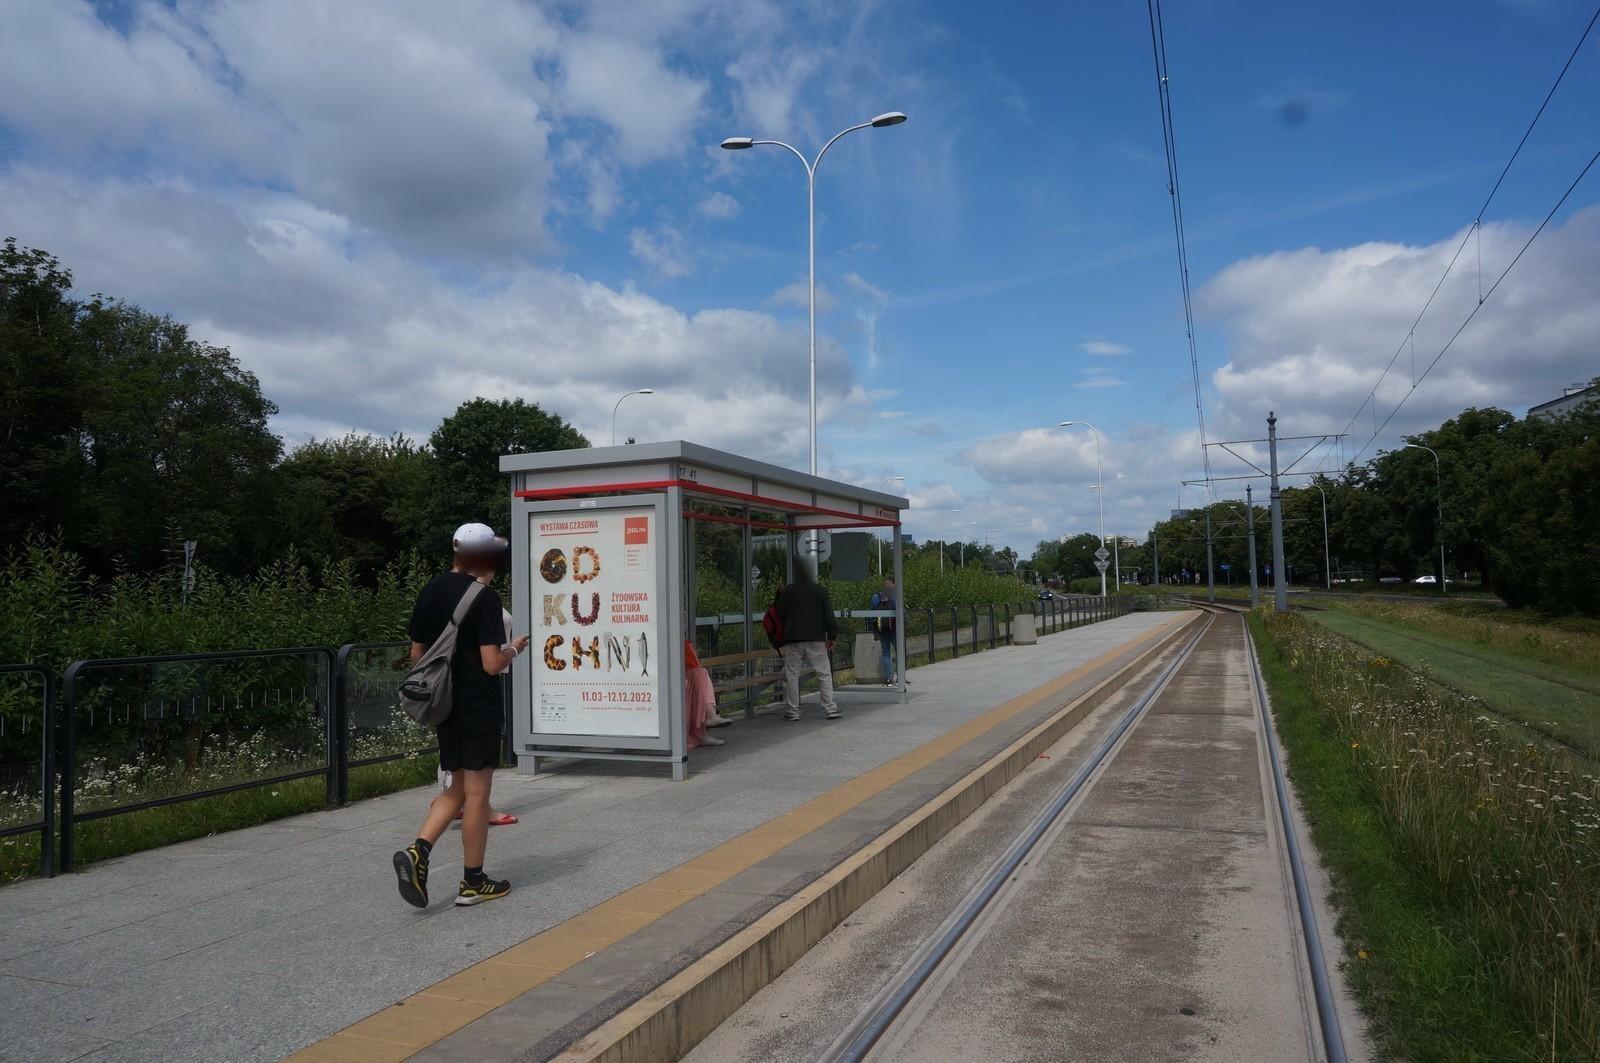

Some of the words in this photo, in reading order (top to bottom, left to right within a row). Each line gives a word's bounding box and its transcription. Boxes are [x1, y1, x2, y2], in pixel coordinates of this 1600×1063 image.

[540, 522, 568, 531] WYSTAWA
[570, 520, 599, 530] CZASOWA
[540, 546, 600, 584] OD
[611, 592, 648, 602] ŻYDOWSKA
[543, 592, 600, 626] KU
[611, 603, 640, 612] KULTURA
[611, 614, 649, 623] KULINARNA
